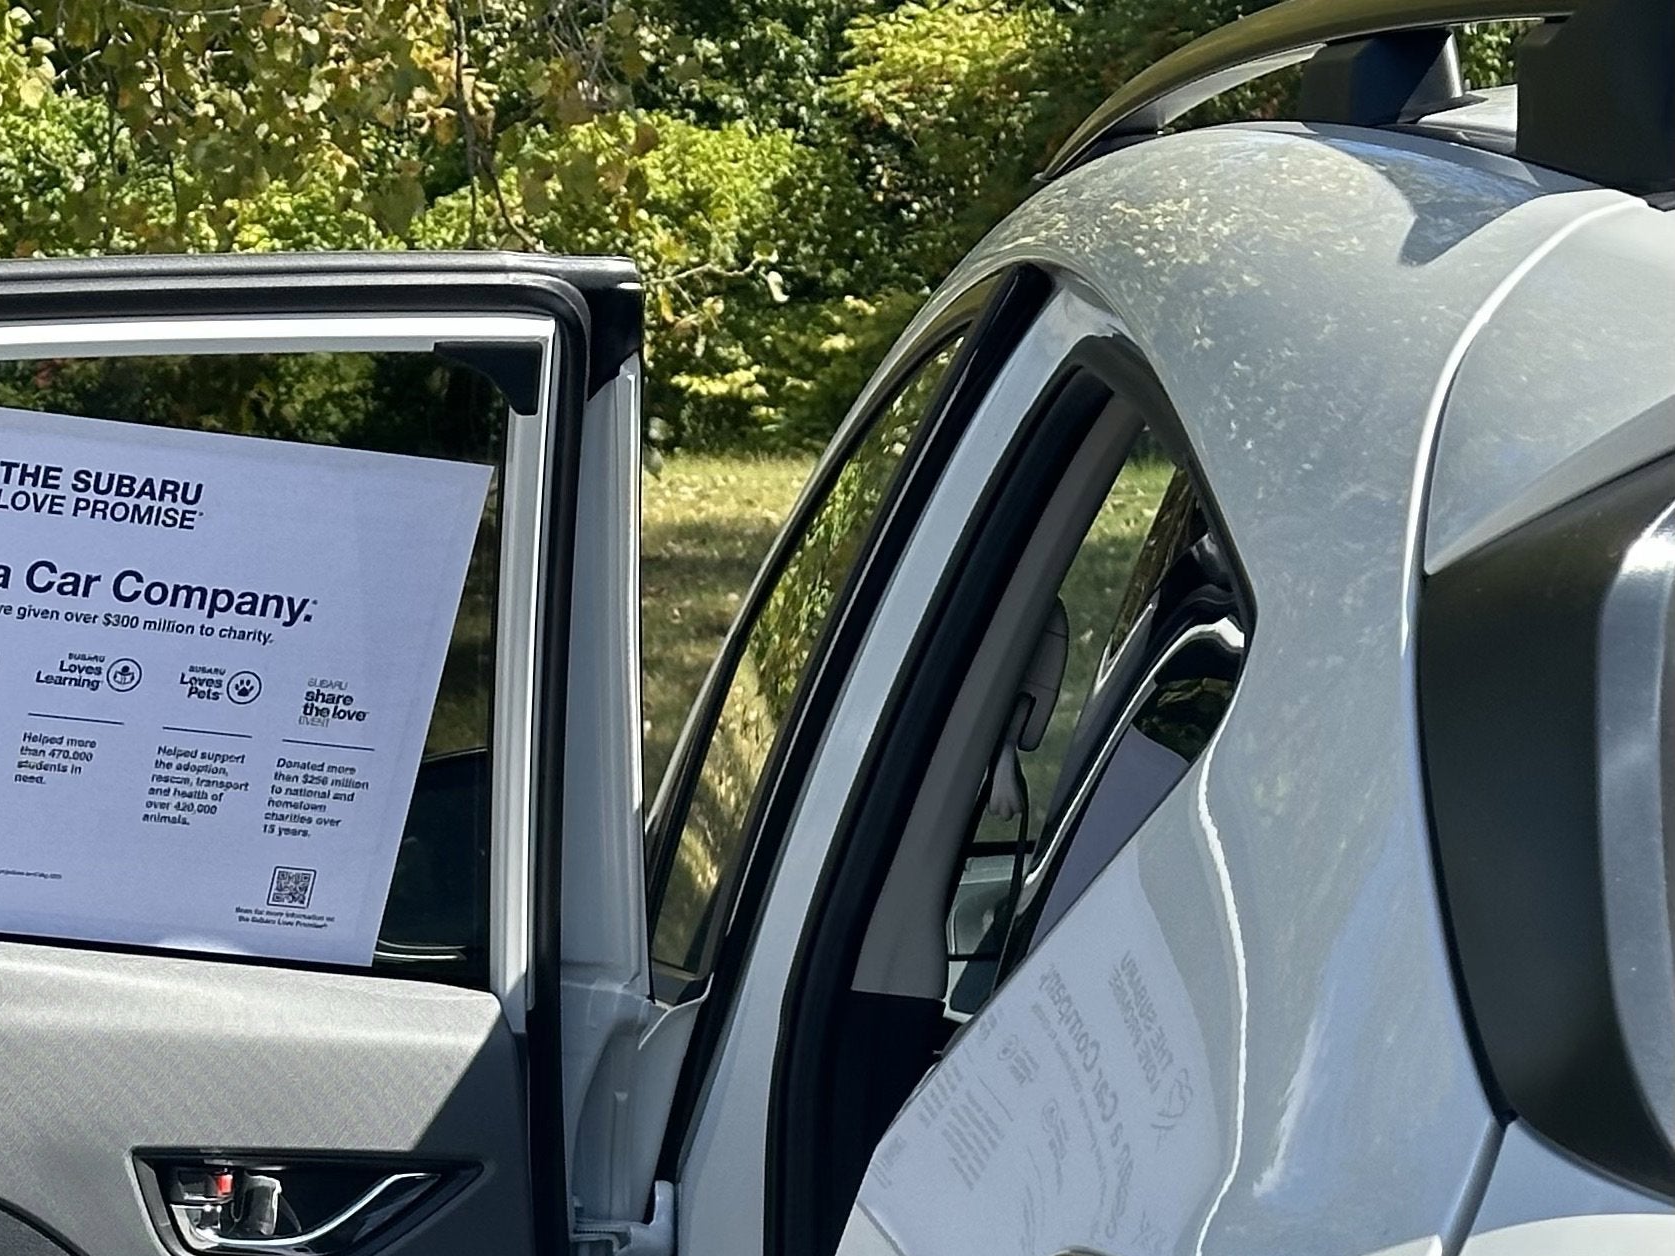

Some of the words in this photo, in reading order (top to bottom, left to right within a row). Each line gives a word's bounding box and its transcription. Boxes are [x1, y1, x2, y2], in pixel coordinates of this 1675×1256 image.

[0, 460, 63, 490] THE
[70, 468, 203, 506] SUBARU
[25, 559, 102, 598] Car
[15, 604, 60, 621] given
[63, 610, 99, 624] over
[101, 612, 139, 629] $300
[142, 617, 195, 635] million
[198, 623, 215, 637] to
[218, 625, 273, 646] charity.
[58, 659, 102, 676] Loves
[34, 670, 101, 692] Learning
[178, 671, 223, 689] Loves
[186, 685, 222, 701] Pets
[303, 688, 354, 706] share
[302, 701, 331, 718] the
[21, 731, 65, 746] Helped
[65, 737, 97, 749] more
[19, 745, 46, 757] than
[156, 745, 198, 760] Helped
[199, 751, 246, 764] support
[69, 763, 82, 775] in
[154, 758, 173, 770] the
[275, 757, 325, 772] Donated
[326, 764, 356, 775] more
[195, 776, 249, 792] transport
[273, 770, 299, 783] than
[329, 777, 369, 790] million
[147, 786, 171, 797] and
[172, 787, 208, 800] health
[210, 791, 224, 802] of
[270, 783, 283, 795] to
[283, 787, 331, 799] national
[331, 791, 355, 802] and
[144, 799, 170, 811] over
[263, 811, 313, 825] charities
[315, 817, 342, 827] over
[262, 823, 276, 834] 15
